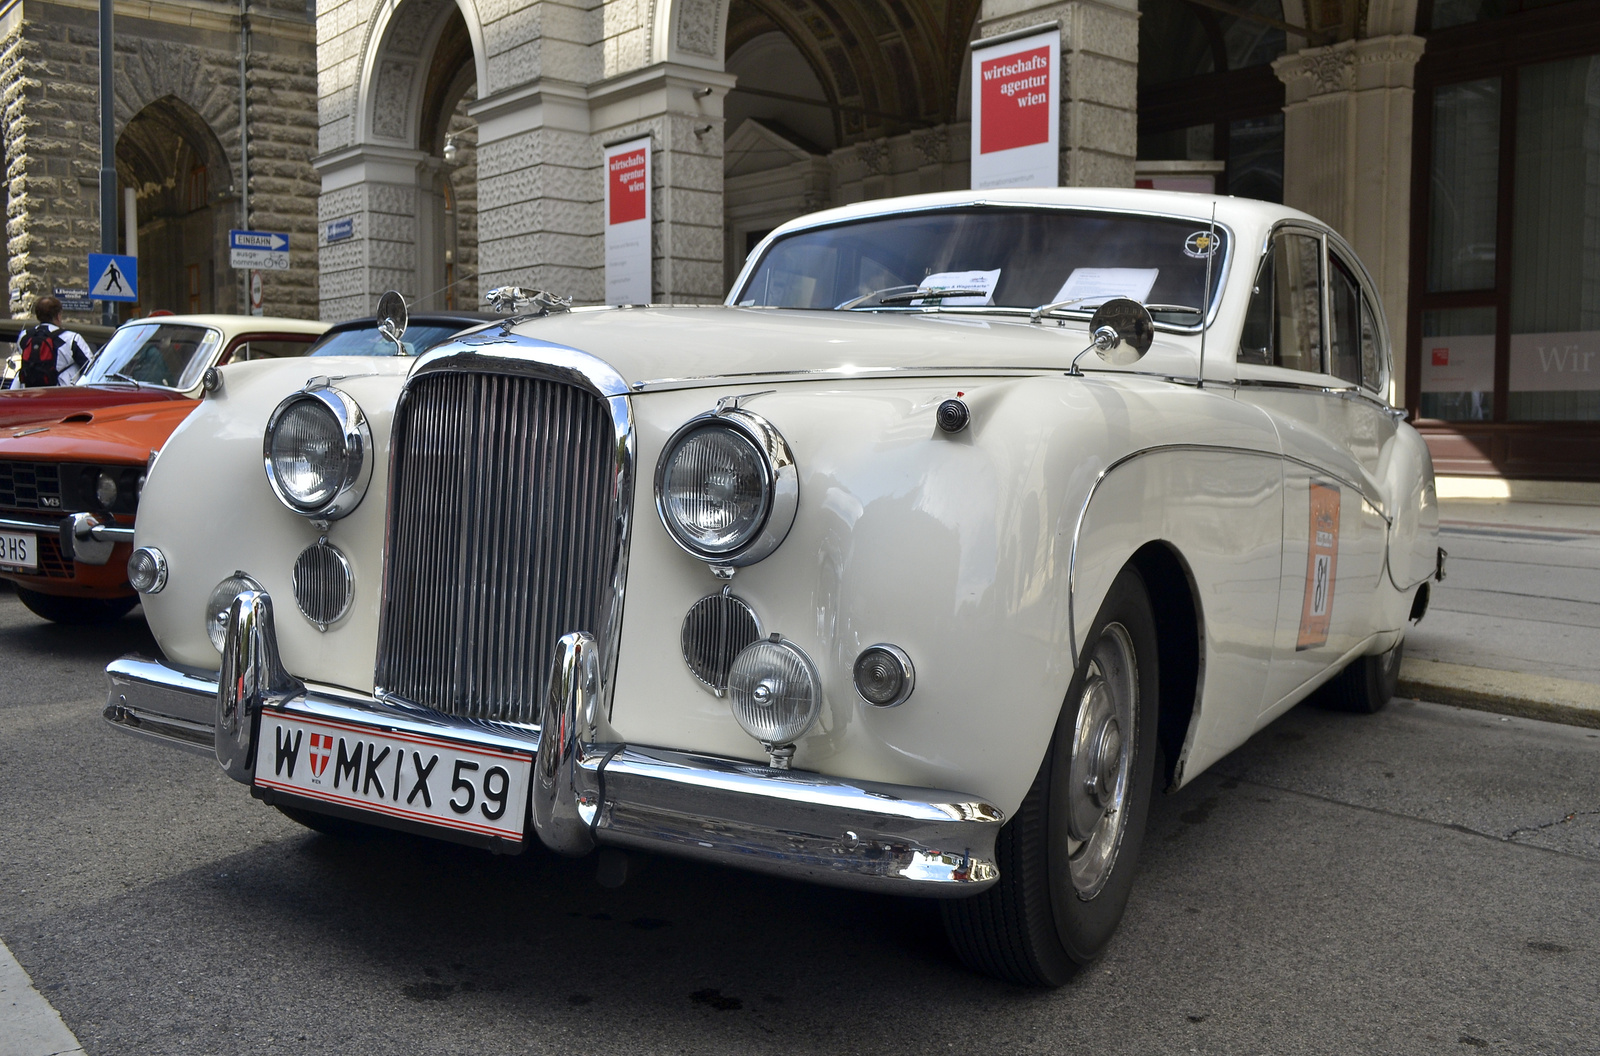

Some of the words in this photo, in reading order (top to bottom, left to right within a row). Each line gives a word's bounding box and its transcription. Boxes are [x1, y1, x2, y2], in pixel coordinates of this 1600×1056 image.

[983, 55, 1047, 81] wirtschafts
[1000, 74, 1047, 97] agentur
[1017, 92, 1047, 108] wien
[610, 154, 645, 172] wirtschafts
[619, 168, 645, 184] agentur
[628, 181, 645, 192] wien
[237, 234, 271, 246] EINBAHN
[232, 259, 263, 268] nommen
[1537, 344, 1596, 373] Wir
[41, 497, 60, 507] V8
[8, 537, 27, 560] HS
[276, 725, 303, 778] W
[333, 737, 440, 808] MKIX
[449, 759, 510, 821] 59
